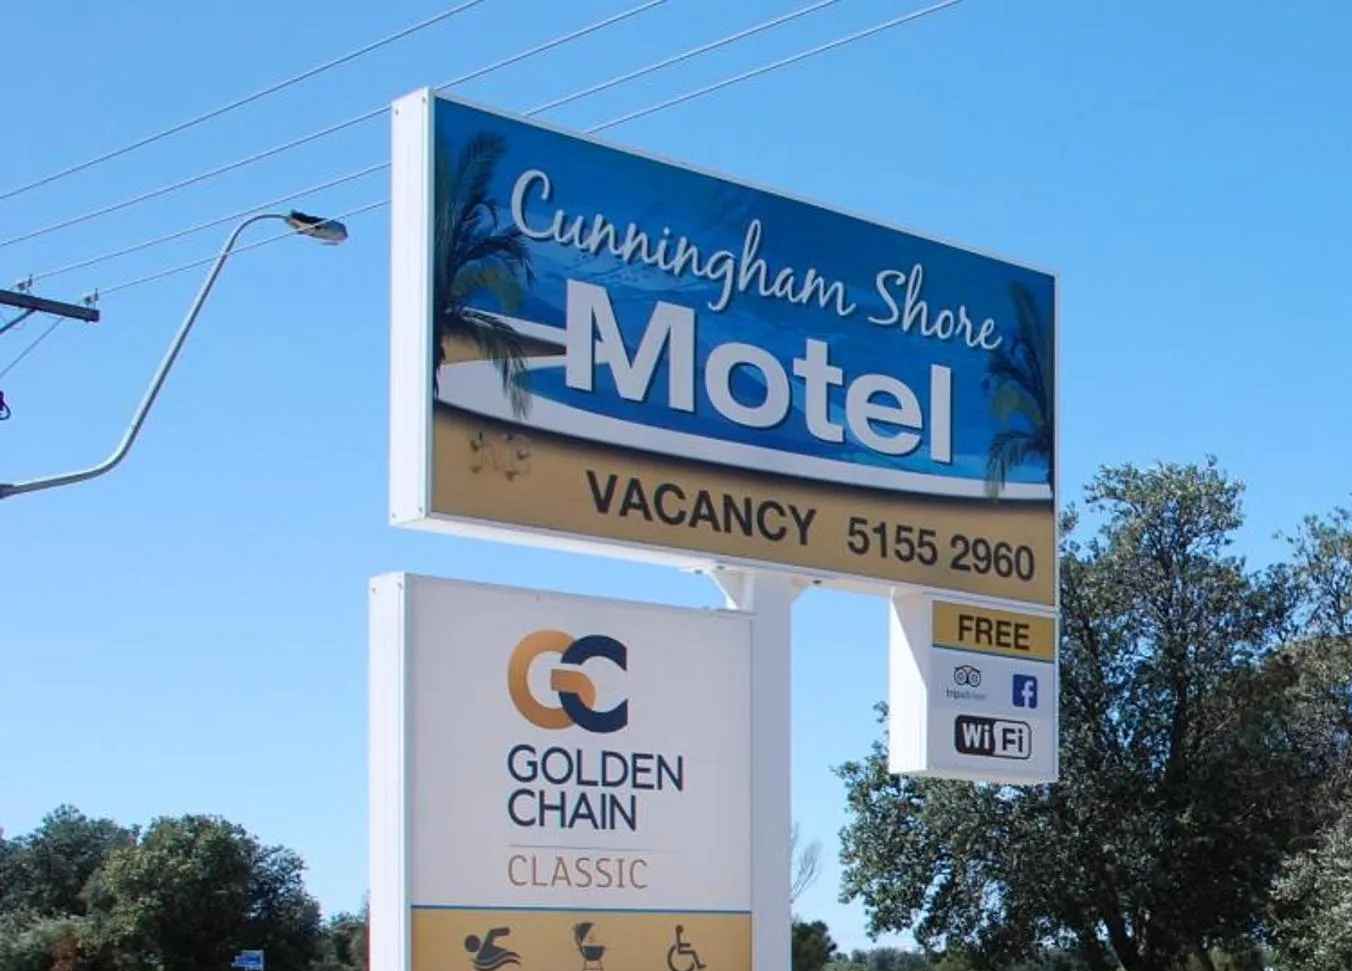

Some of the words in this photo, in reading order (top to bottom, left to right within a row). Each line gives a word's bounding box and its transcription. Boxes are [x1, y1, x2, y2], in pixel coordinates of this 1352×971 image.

[511, 168, 857, 314] Cunningham
[867, 264, 1003, 350] Shore
[565, 278, 953, 463] Motel
[586, 470, 817, 546] VACANCY
[847, 516, 938, 566] 5155
[950, 534, 1035, 582] 2960
[958, 613, 1030, 651] FREE
[508, 743, 684, 792] GOLDEN
[508, 788, 637, 832] CHAIN
[508, 854, 649, 889] CLASSIC
